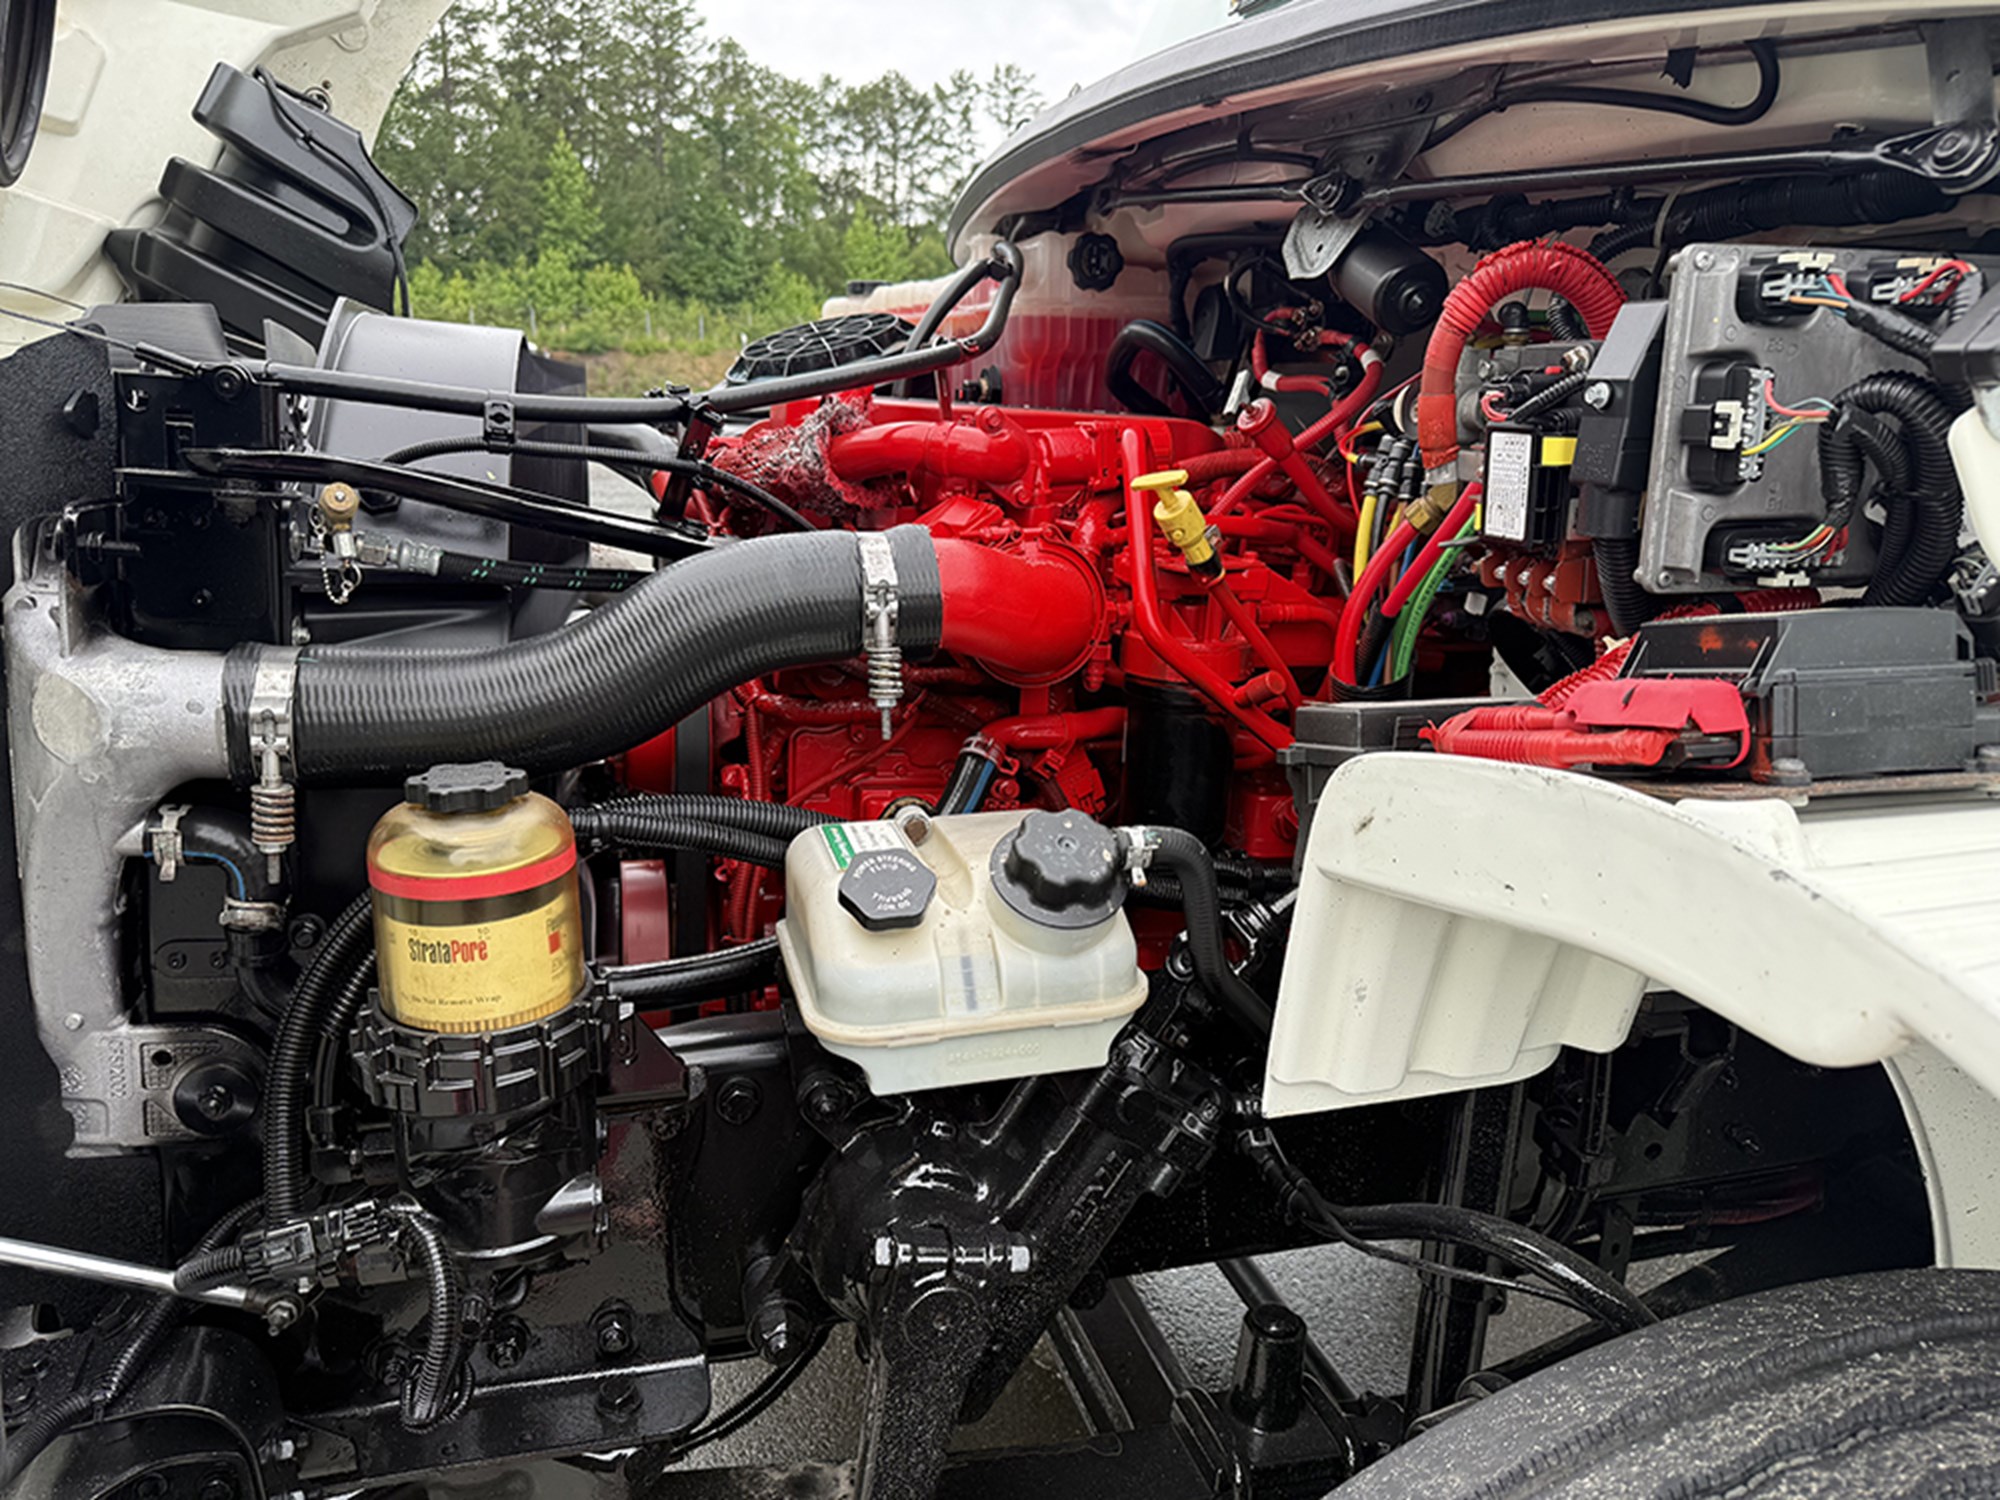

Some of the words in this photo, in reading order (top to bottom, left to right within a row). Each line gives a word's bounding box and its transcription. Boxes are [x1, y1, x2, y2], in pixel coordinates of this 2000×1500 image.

[853, 858, 876, 879] POWER
[876, 855, 917, 873] STEERING
[407, 937, 489, 964] StrataPore
